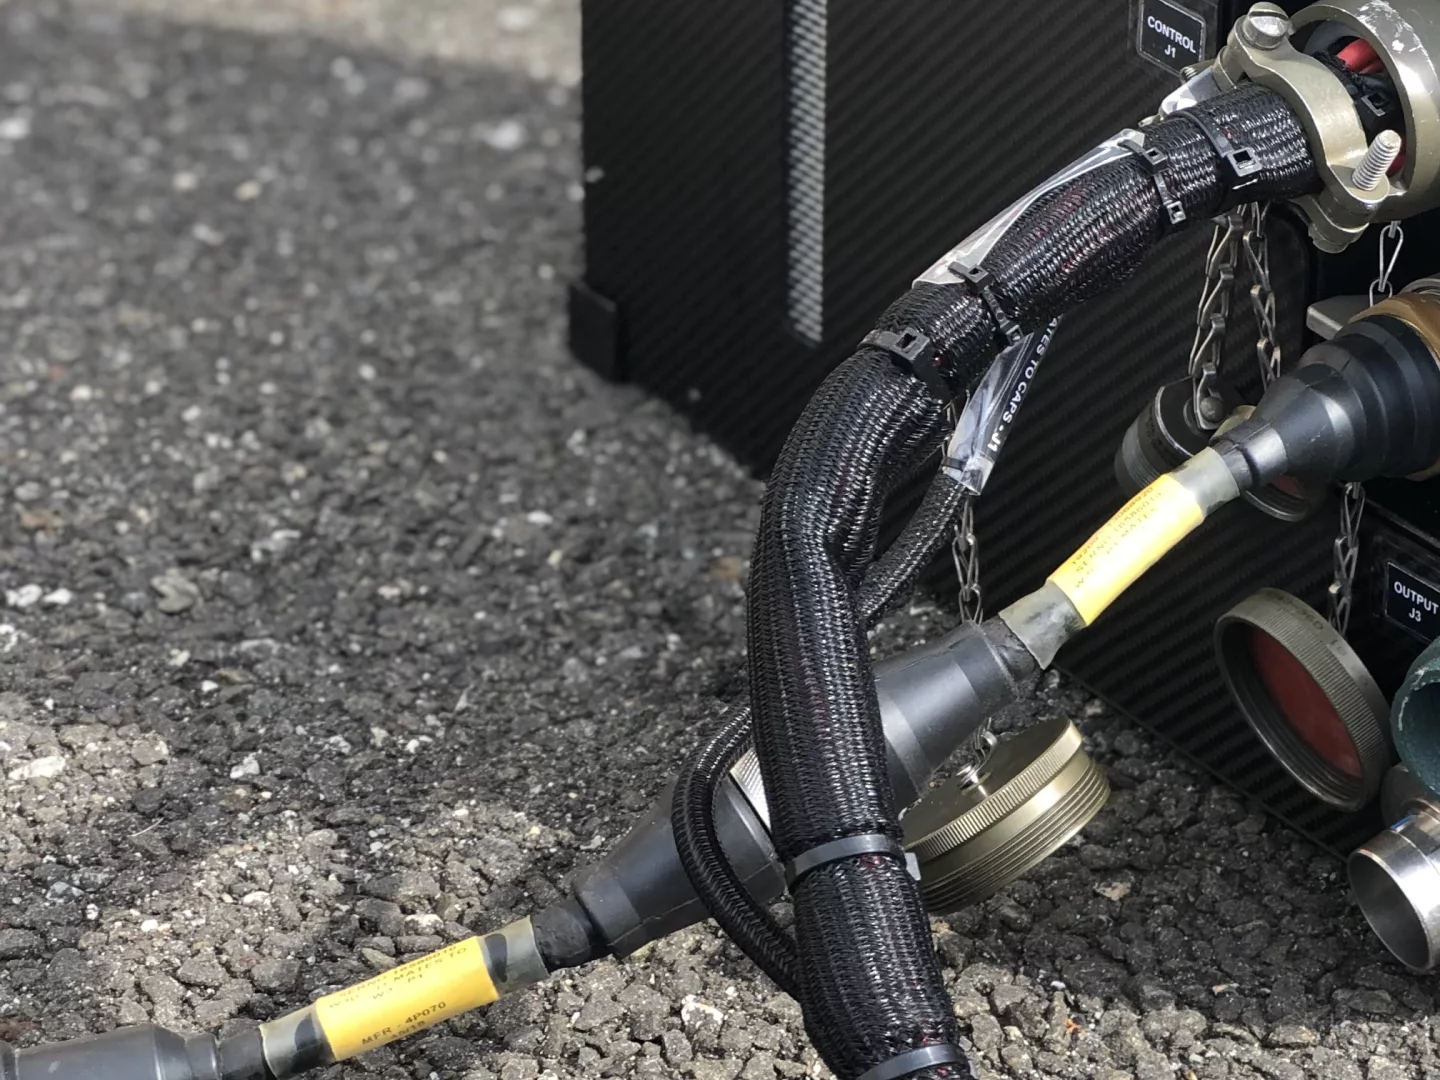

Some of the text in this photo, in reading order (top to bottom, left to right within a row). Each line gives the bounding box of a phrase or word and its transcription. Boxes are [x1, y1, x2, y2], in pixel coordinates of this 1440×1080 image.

[1147, 15, 1197, 54] CONTROL
[1164, 44, 1177, 59] J1
[1002, 381, 1027, 424] CAPS
[987, 432, 1002, 452] J1
[1393, 581, 1440, 615] OUTPUT
[1408, 607, 1422, 622] J3
[362, 1024, 392, 1046] MFR
[404, 1001, 447, 1025] 4P070
